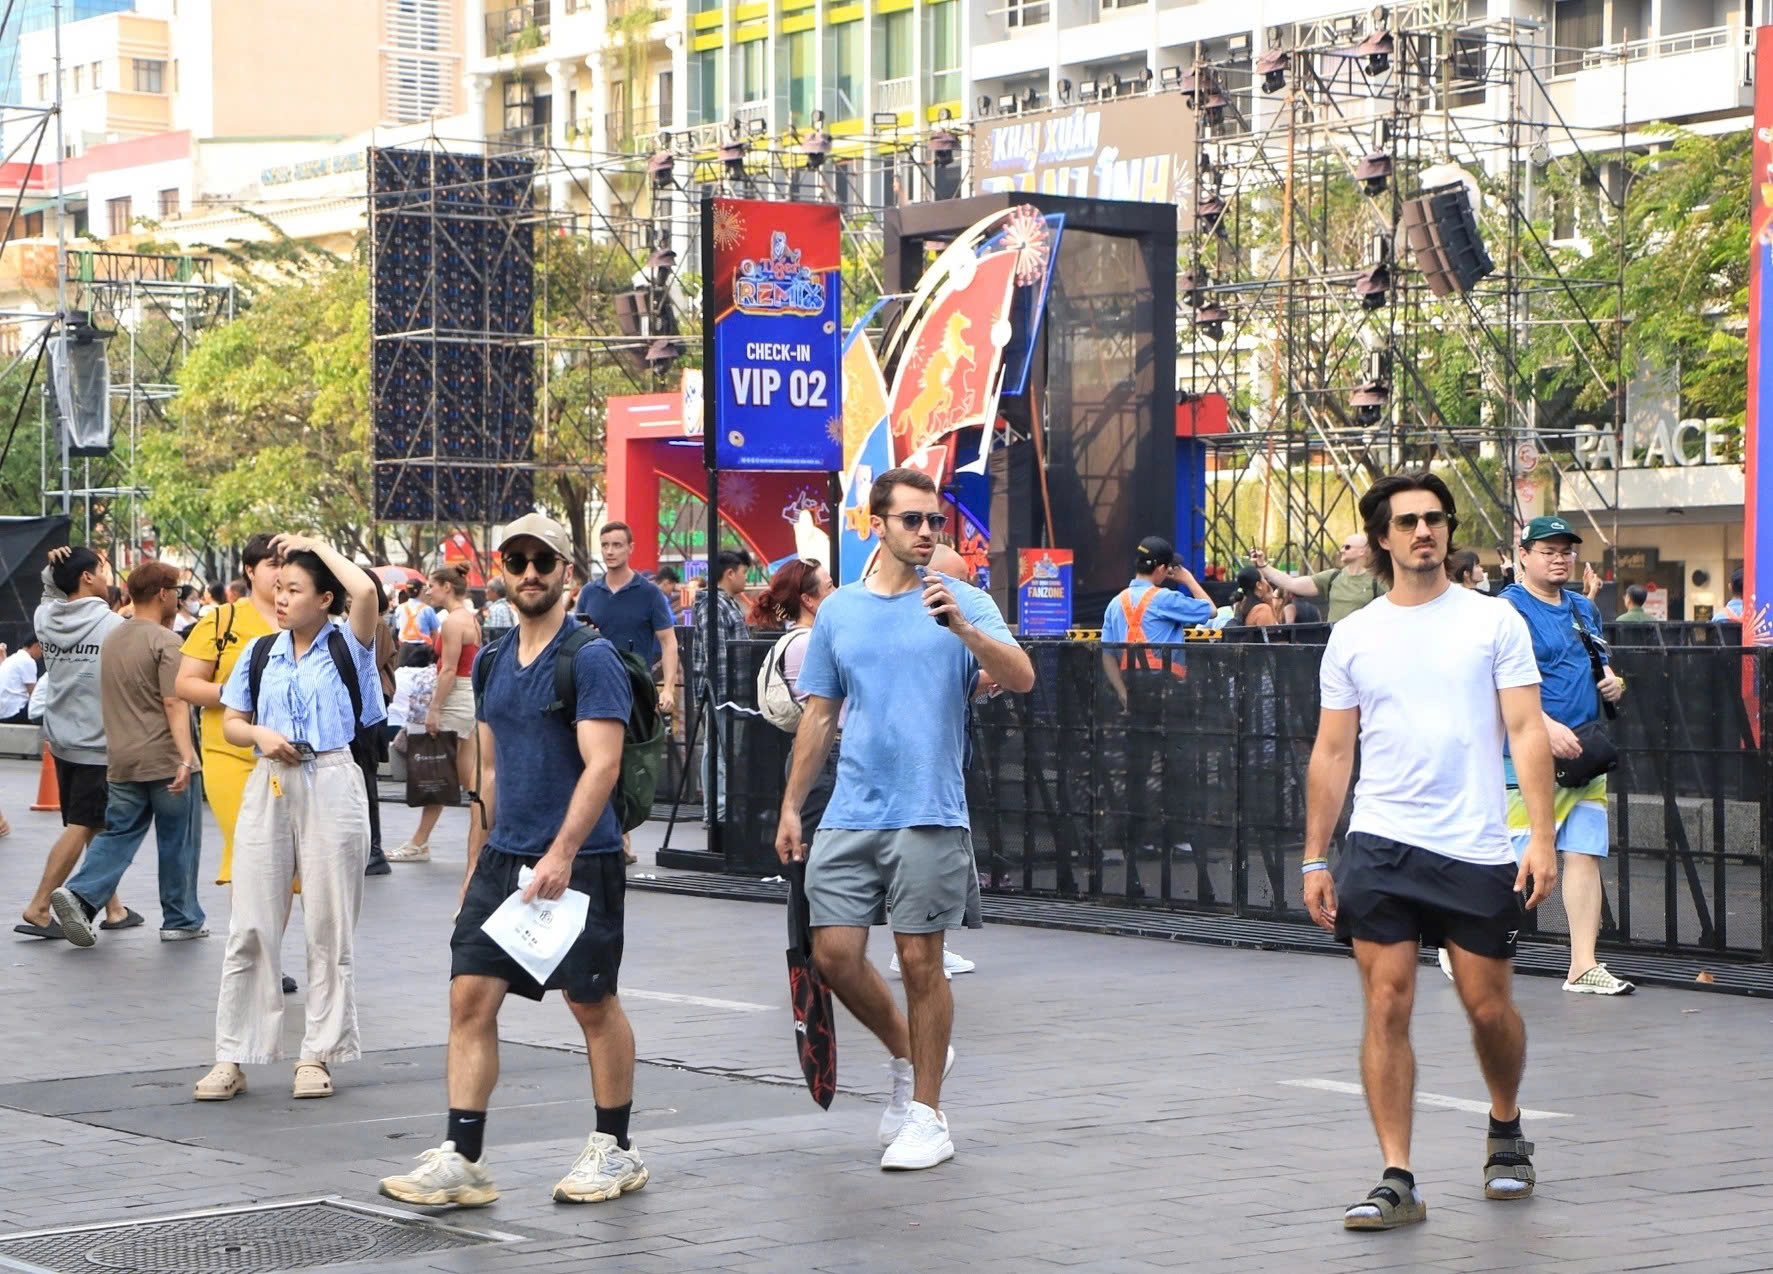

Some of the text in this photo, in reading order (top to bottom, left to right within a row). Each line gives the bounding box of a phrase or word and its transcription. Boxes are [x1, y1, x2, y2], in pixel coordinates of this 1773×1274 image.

[736, 280, 825, 309] REMIX
[746, 342, 811, 361] CHECK-IN
[730, 367, 828, 407] VIP 02
[1574, 418, 1729, 469] PALACE
[1027, 586, 1065, 598] FANZONE
